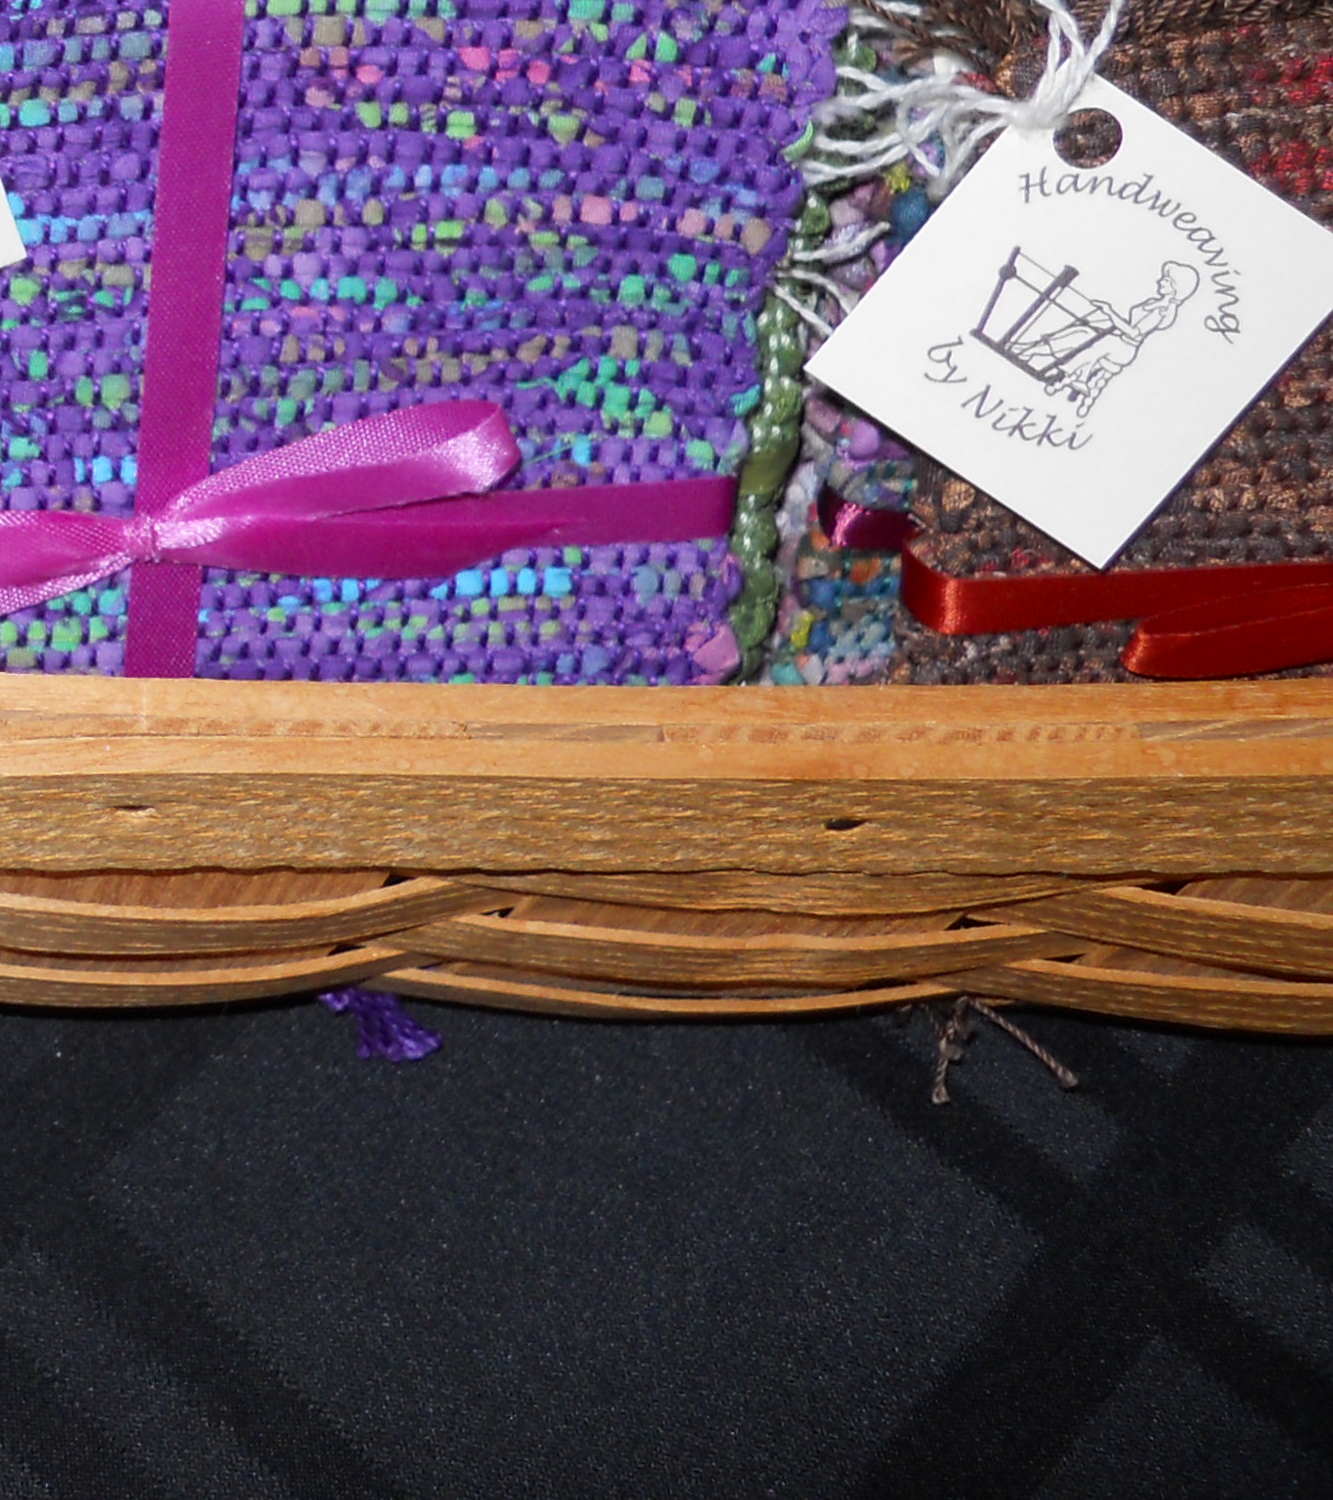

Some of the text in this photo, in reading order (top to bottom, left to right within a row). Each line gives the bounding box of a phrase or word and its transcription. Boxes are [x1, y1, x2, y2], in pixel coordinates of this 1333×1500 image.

[1017, 166, 1244, 345] Handweaving
[924, 336, 1094, 451] by Nikki
